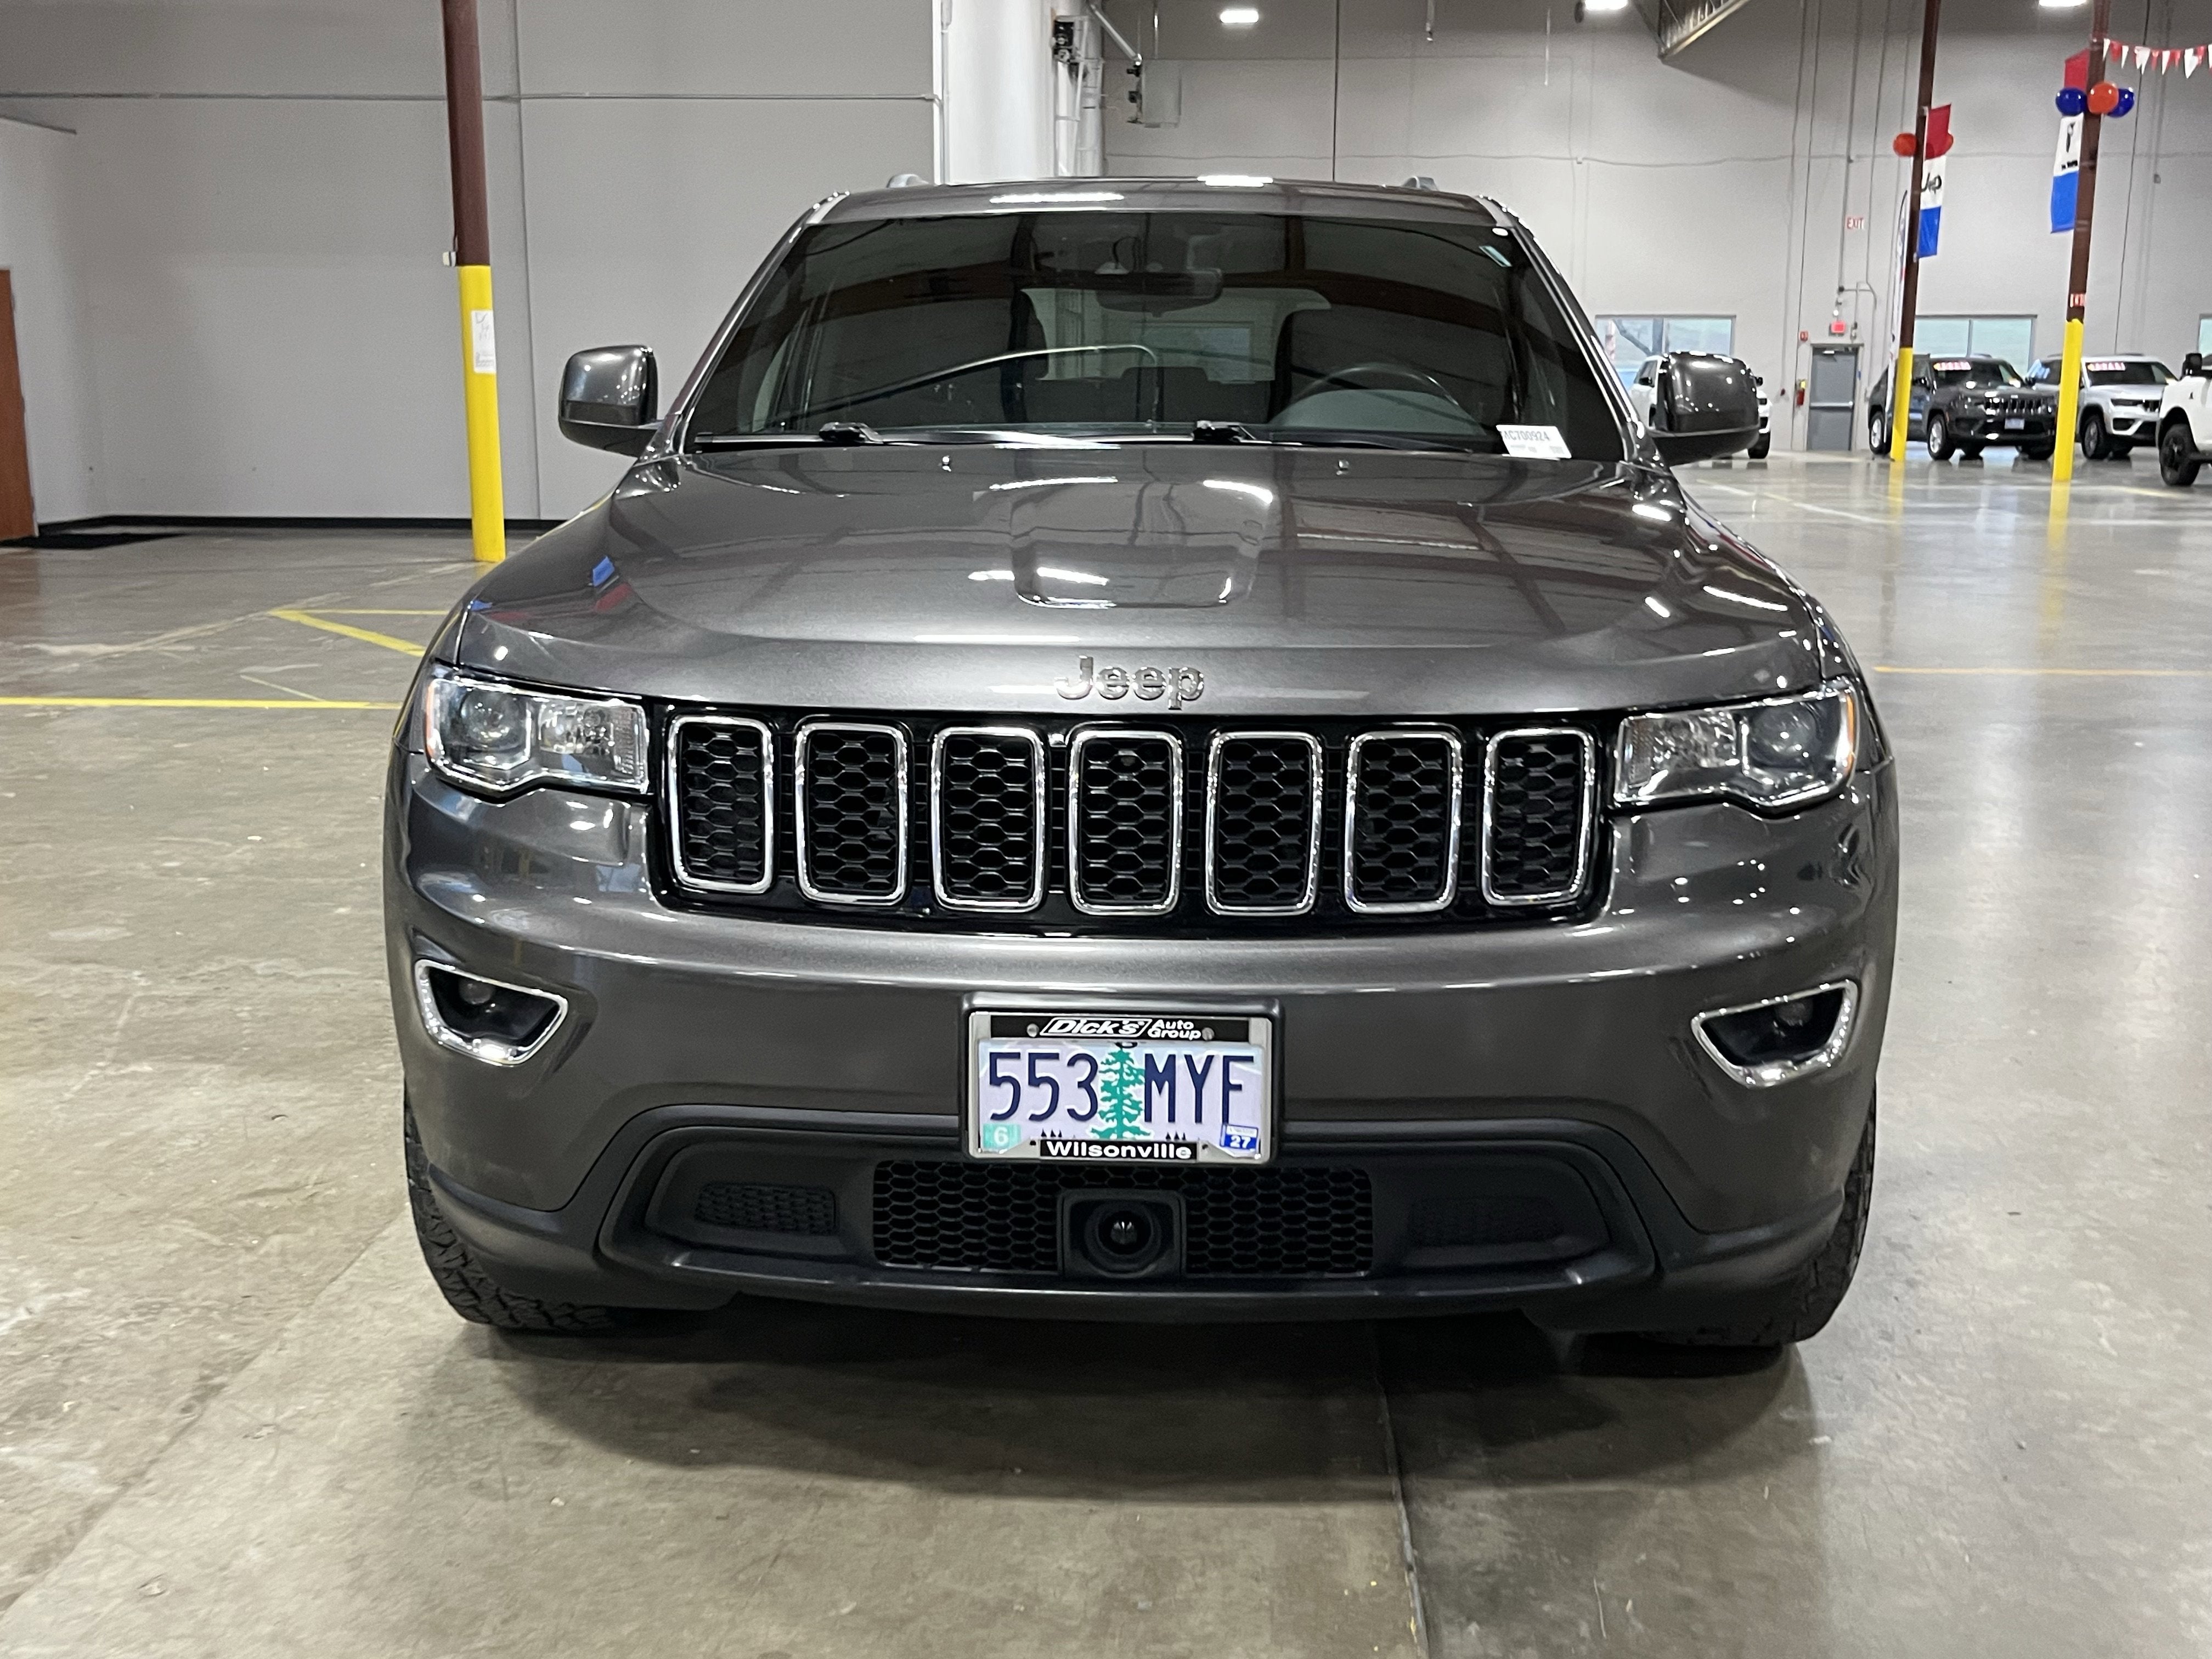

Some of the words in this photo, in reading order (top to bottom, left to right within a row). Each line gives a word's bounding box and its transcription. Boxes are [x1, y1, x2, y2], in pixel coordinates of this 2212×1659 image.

[1053, 655, 1204, 710] Jeep
[1152, 1019, 1194, 1030] Auto
[1147, 1028, 1201, 1040] Group
[989, 1052, 1098, 1121] 553
[1144, 1053, 1254, 1124] MYF
[994, 1126, 1009, 1147] 6
[1230, 1135, 1251, 1149] 27
[1046, 1141, 1192, 1159] Wilsonville
